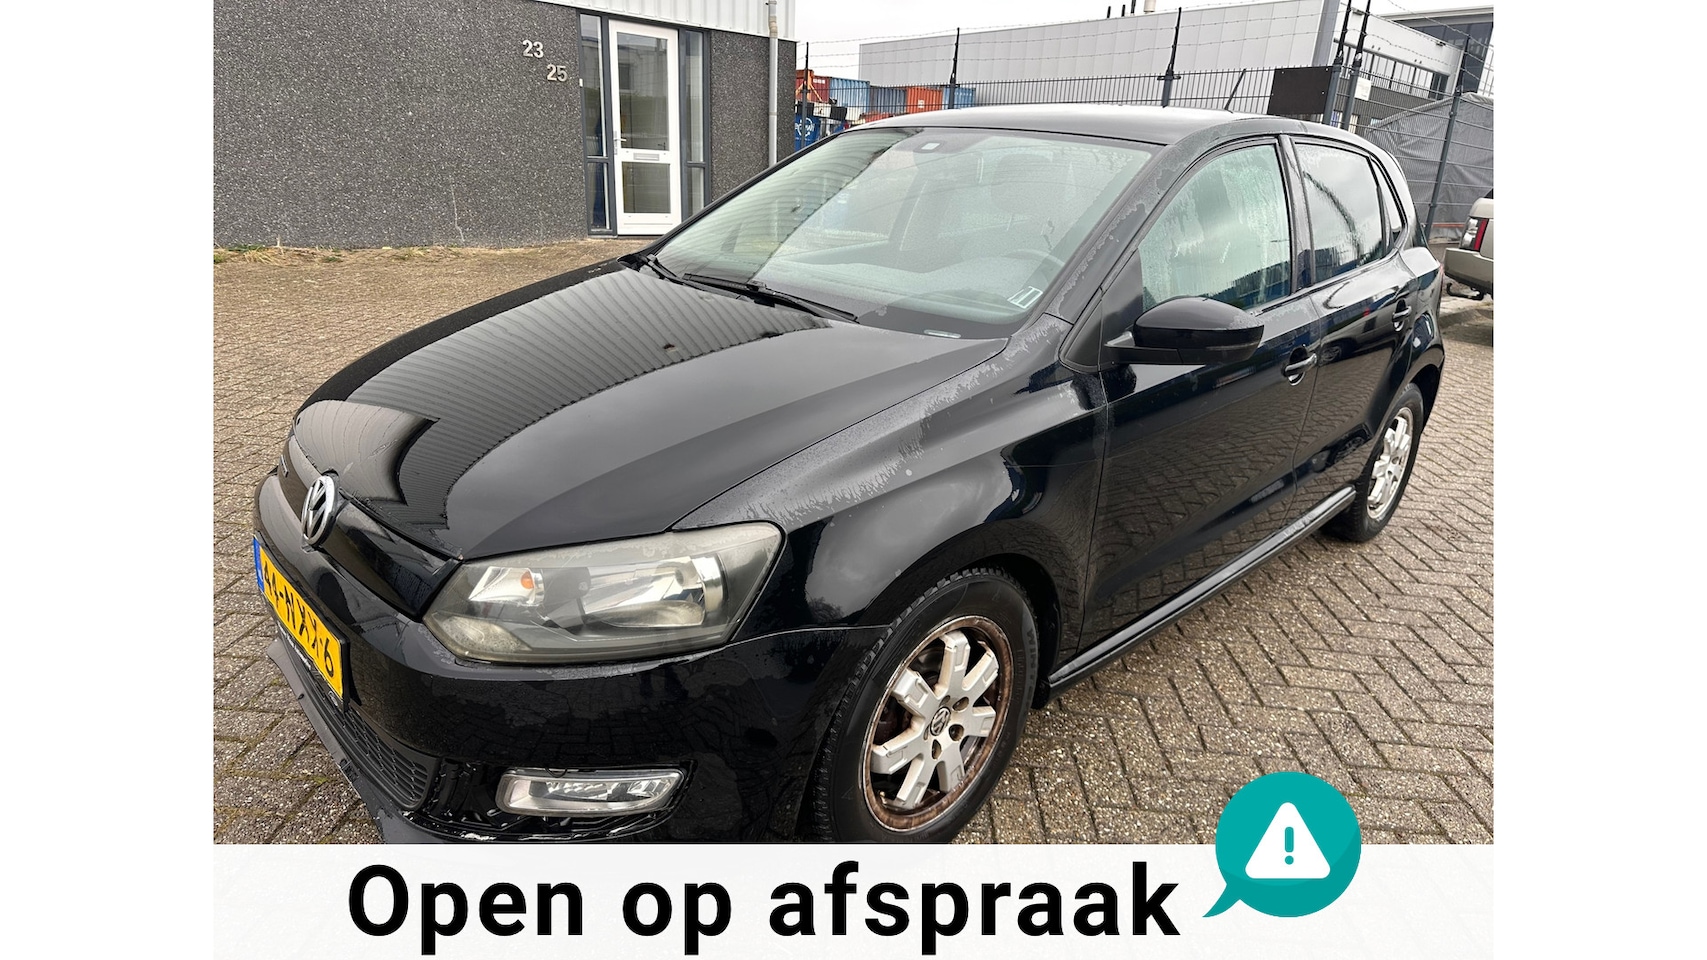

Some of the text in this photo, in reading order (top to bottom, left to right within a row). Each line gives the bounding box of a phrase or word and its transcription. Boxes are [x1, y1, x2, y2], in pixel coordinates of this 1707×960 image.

[522, 39, 544, 58] 23
[546, 64, 568, 82] 25
[263, 560, 335, 679] 44-NXX-6
